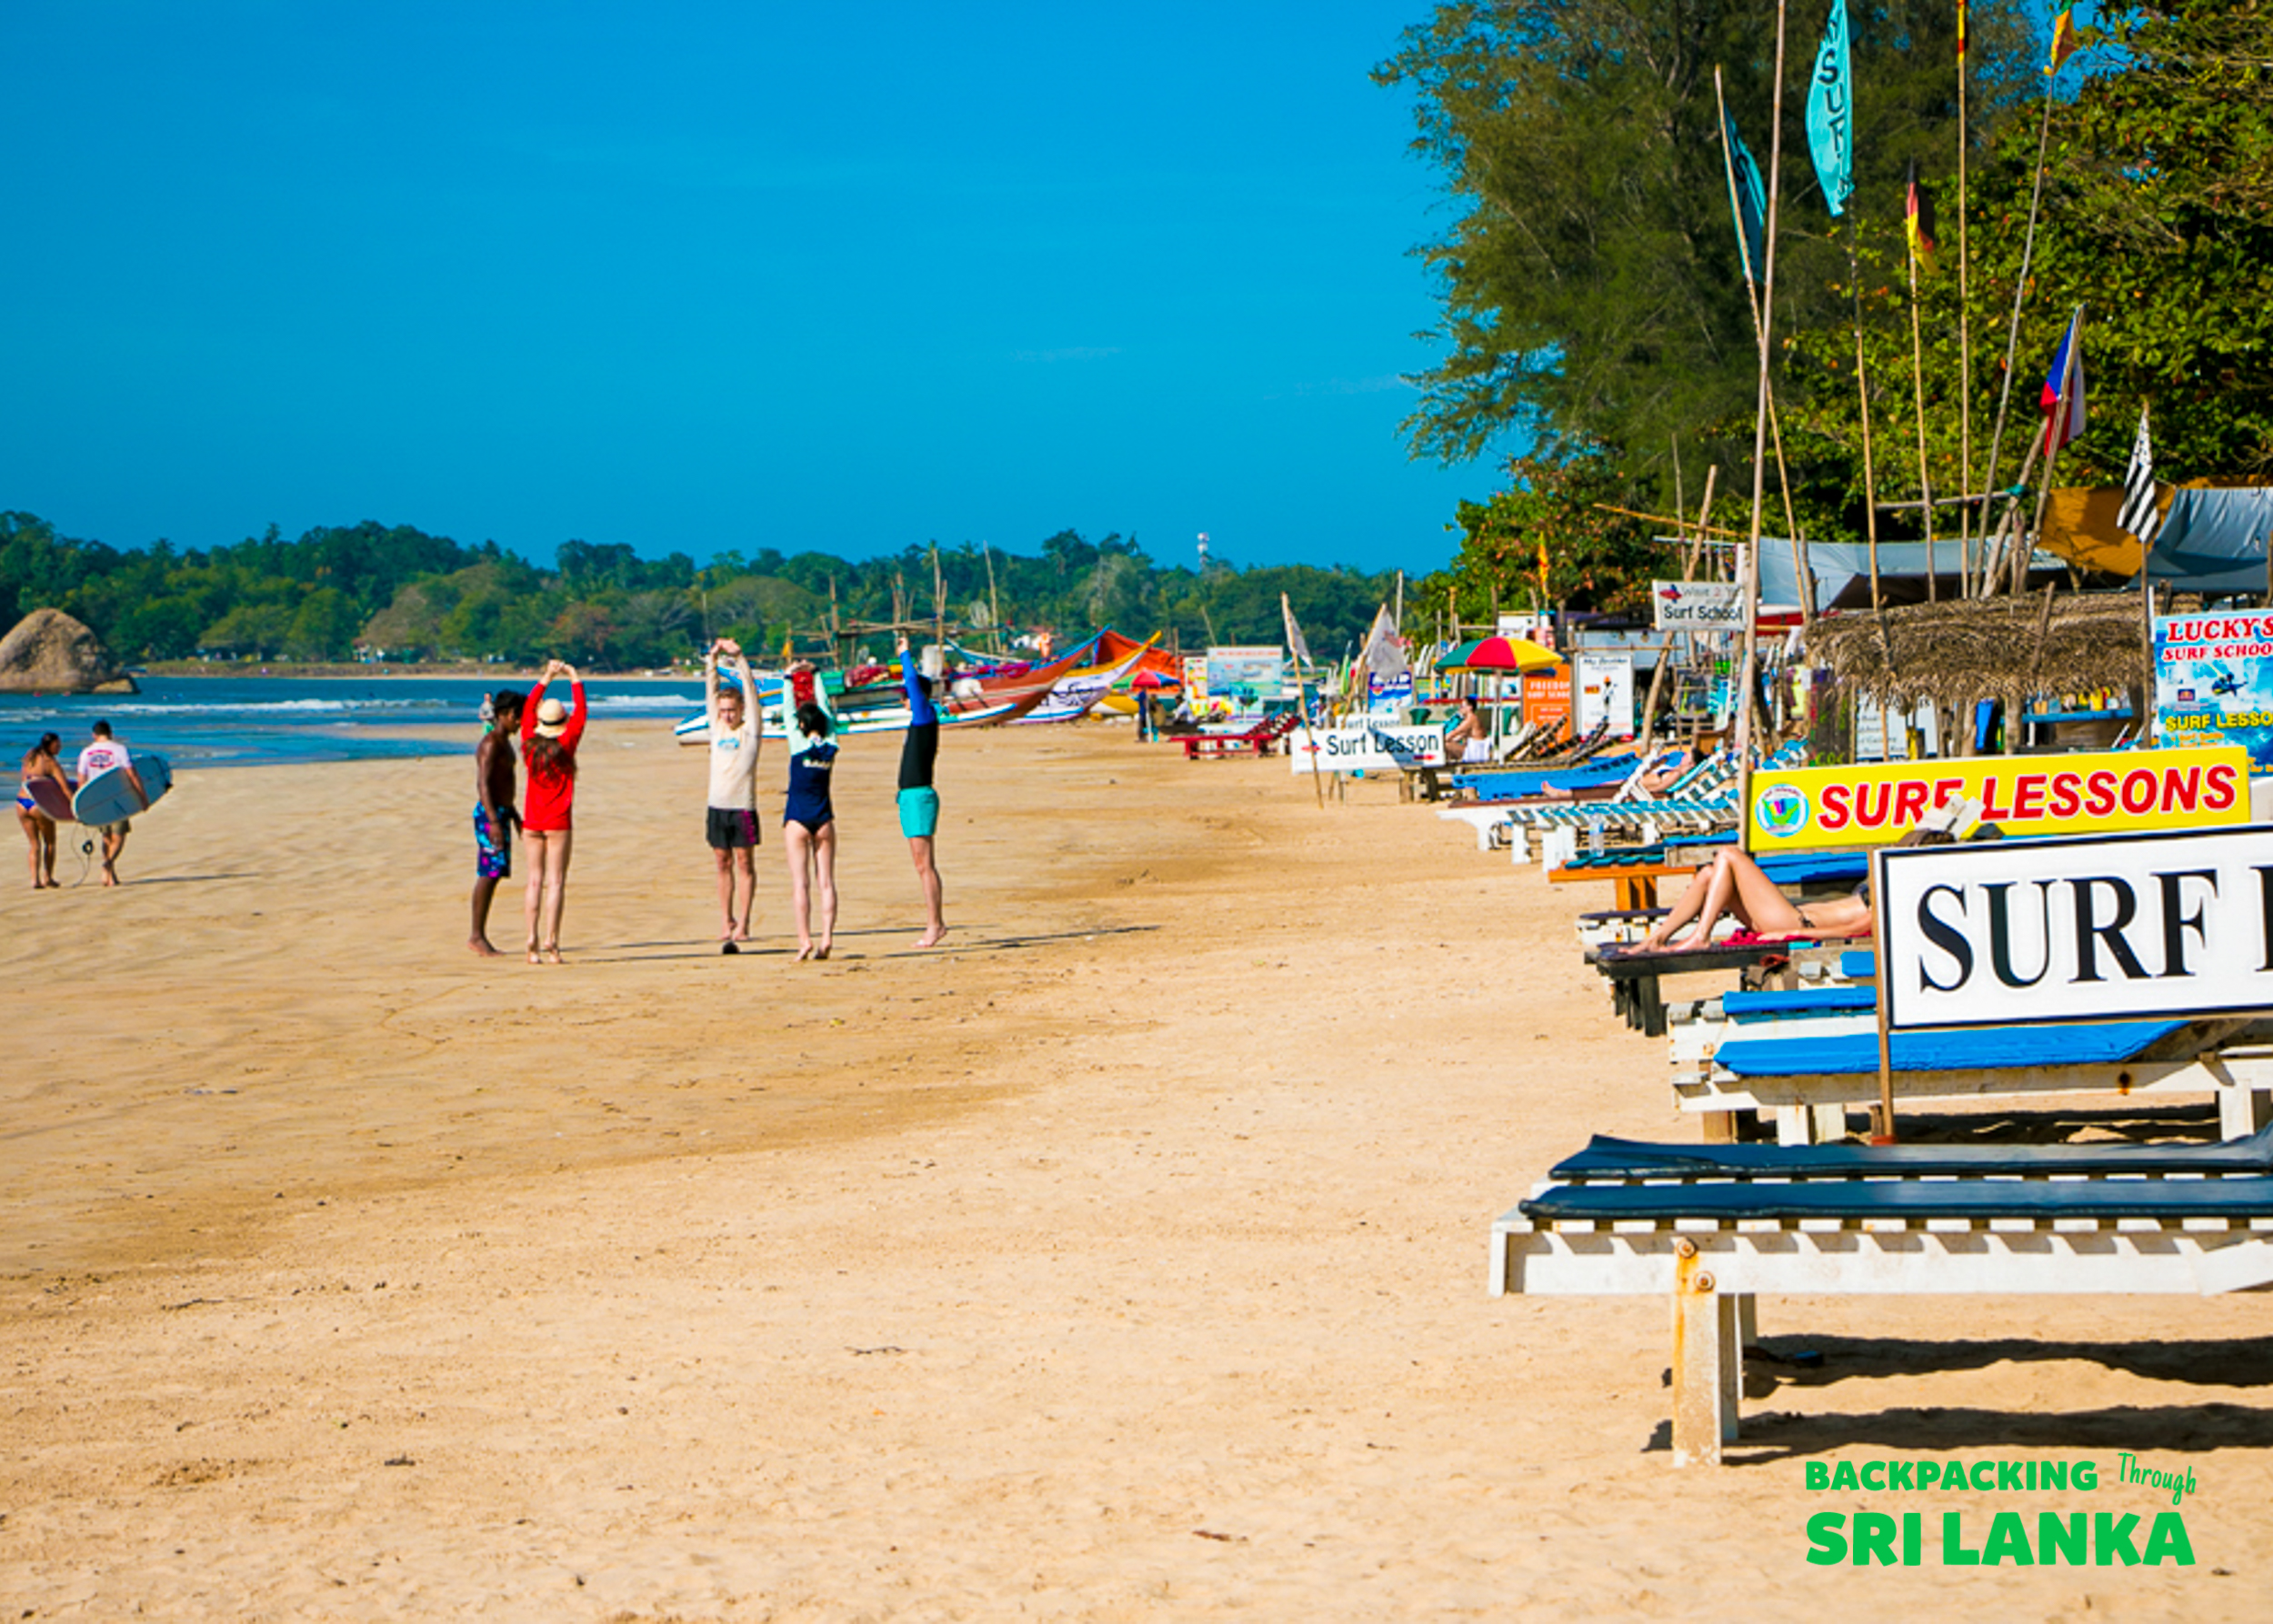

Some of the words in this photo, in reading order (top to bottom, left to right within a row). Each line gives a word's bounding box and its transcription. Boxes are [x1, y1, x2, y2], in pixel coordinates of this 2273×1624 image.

[2163, 648, 2208, 662] SURF
[2213, 643, 2273, 659] SCHOO
[2165, 715, 2211, 733] SURF
[2216, 709, 2273, 728] LESSO
[1326, 734, 1367, 756] Surf
[1374, 733, 1439, 754] Lesson
[1818, 778, 1964, 829] SURF
[1980, 765, 2237, 821] LESSONS
[1917, 868, 2218, 993] SURF
